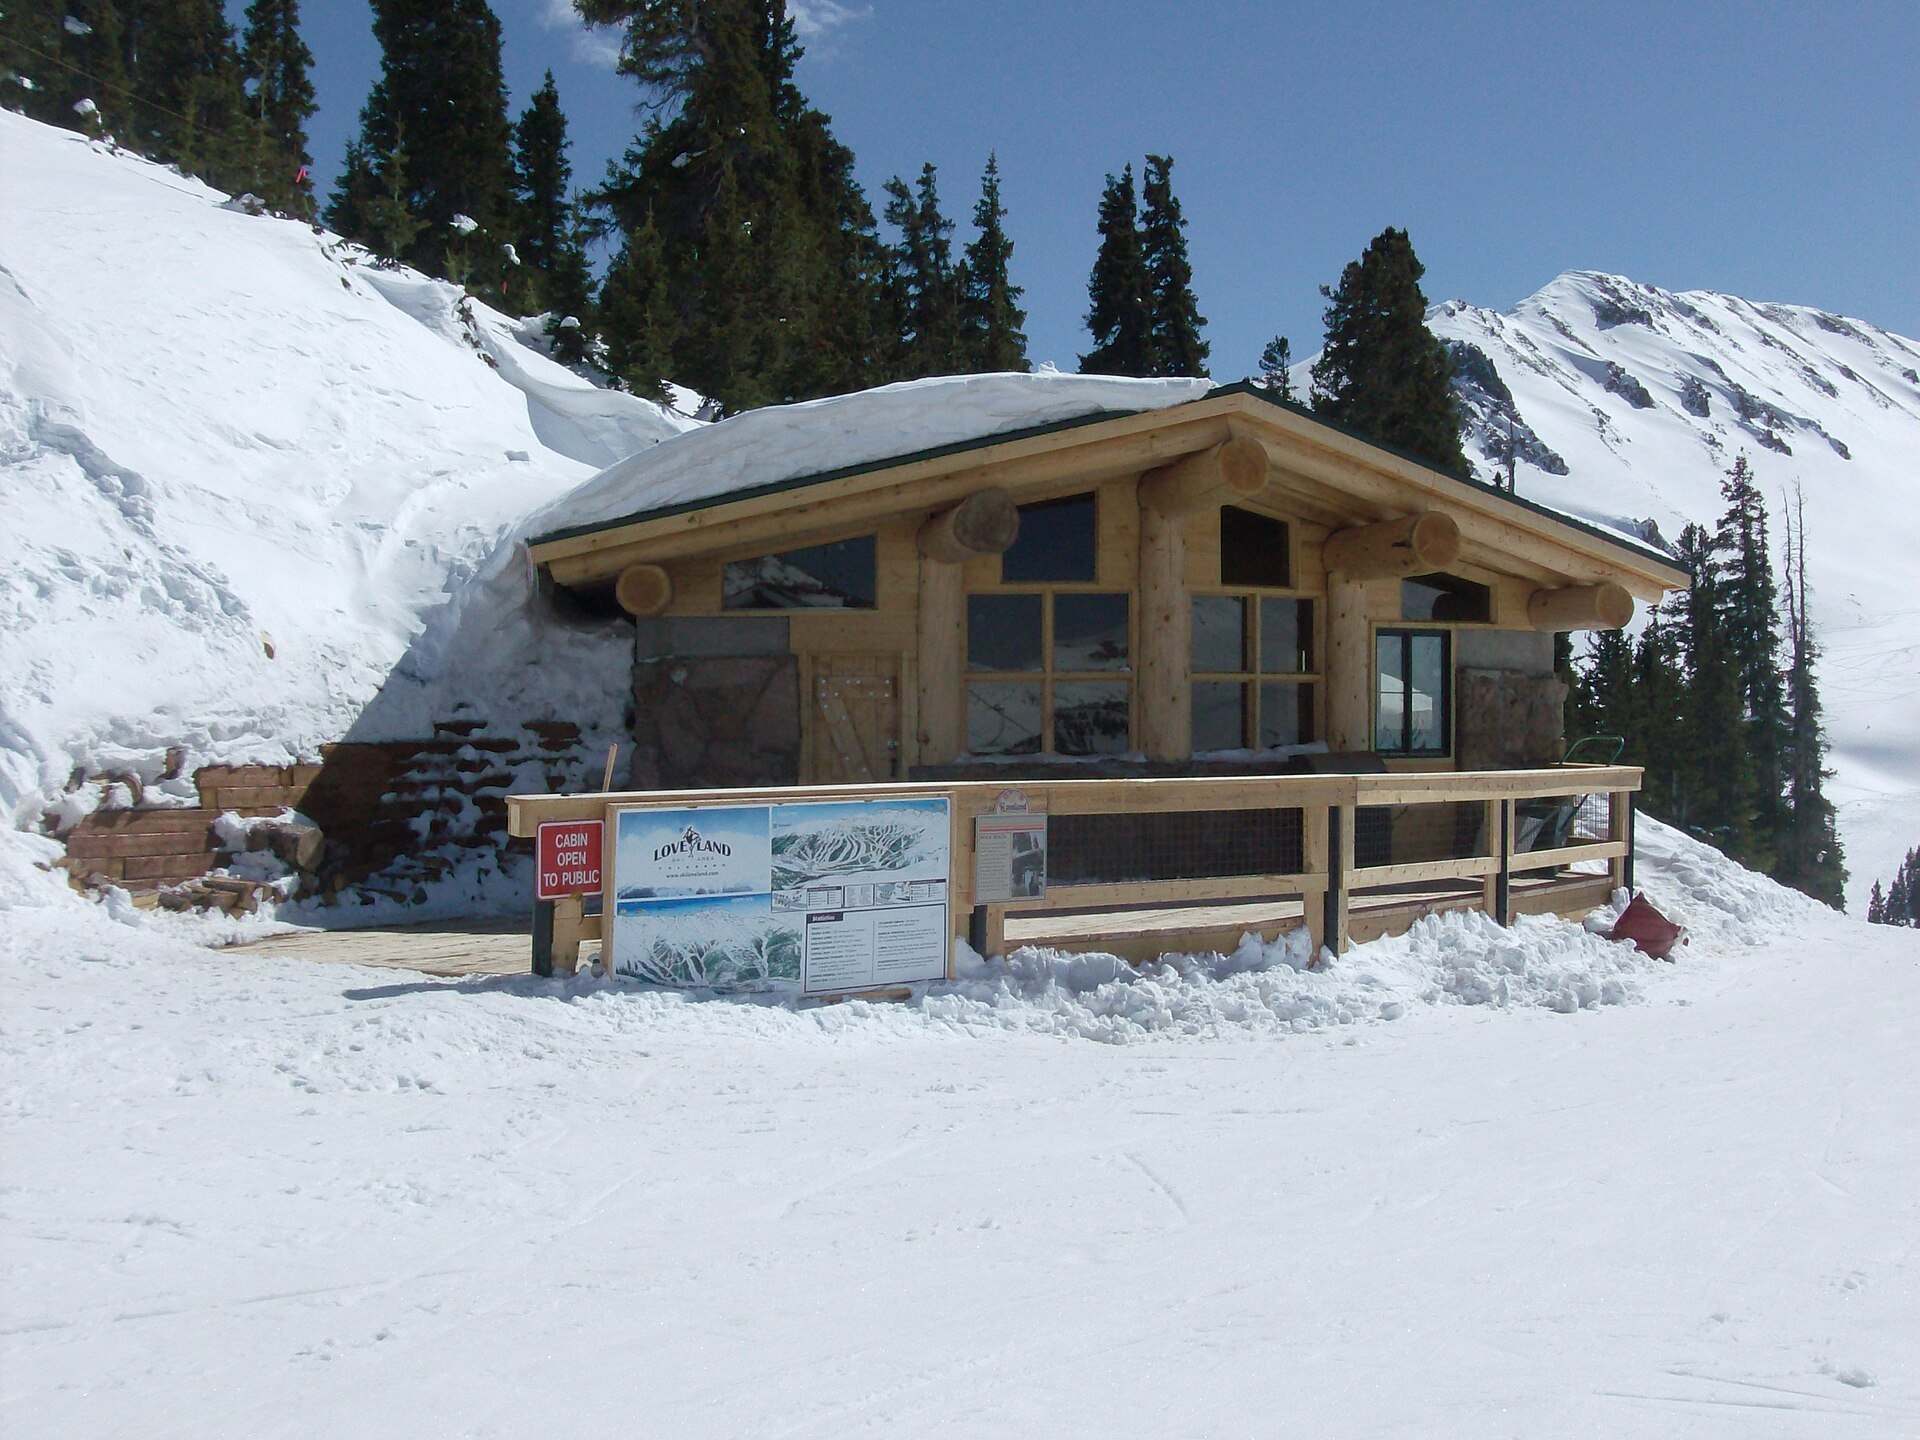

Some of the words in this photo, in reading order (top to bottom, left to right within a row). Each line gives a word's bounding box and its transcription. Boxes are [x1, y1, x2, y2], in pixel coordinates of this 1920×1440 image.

[555, 833, 588, 848] CABIN
[557, 851, 587, 866] OPEN
[543, 872, 558, 887] TO
[562, 869, 600, 886] PUBLIC
